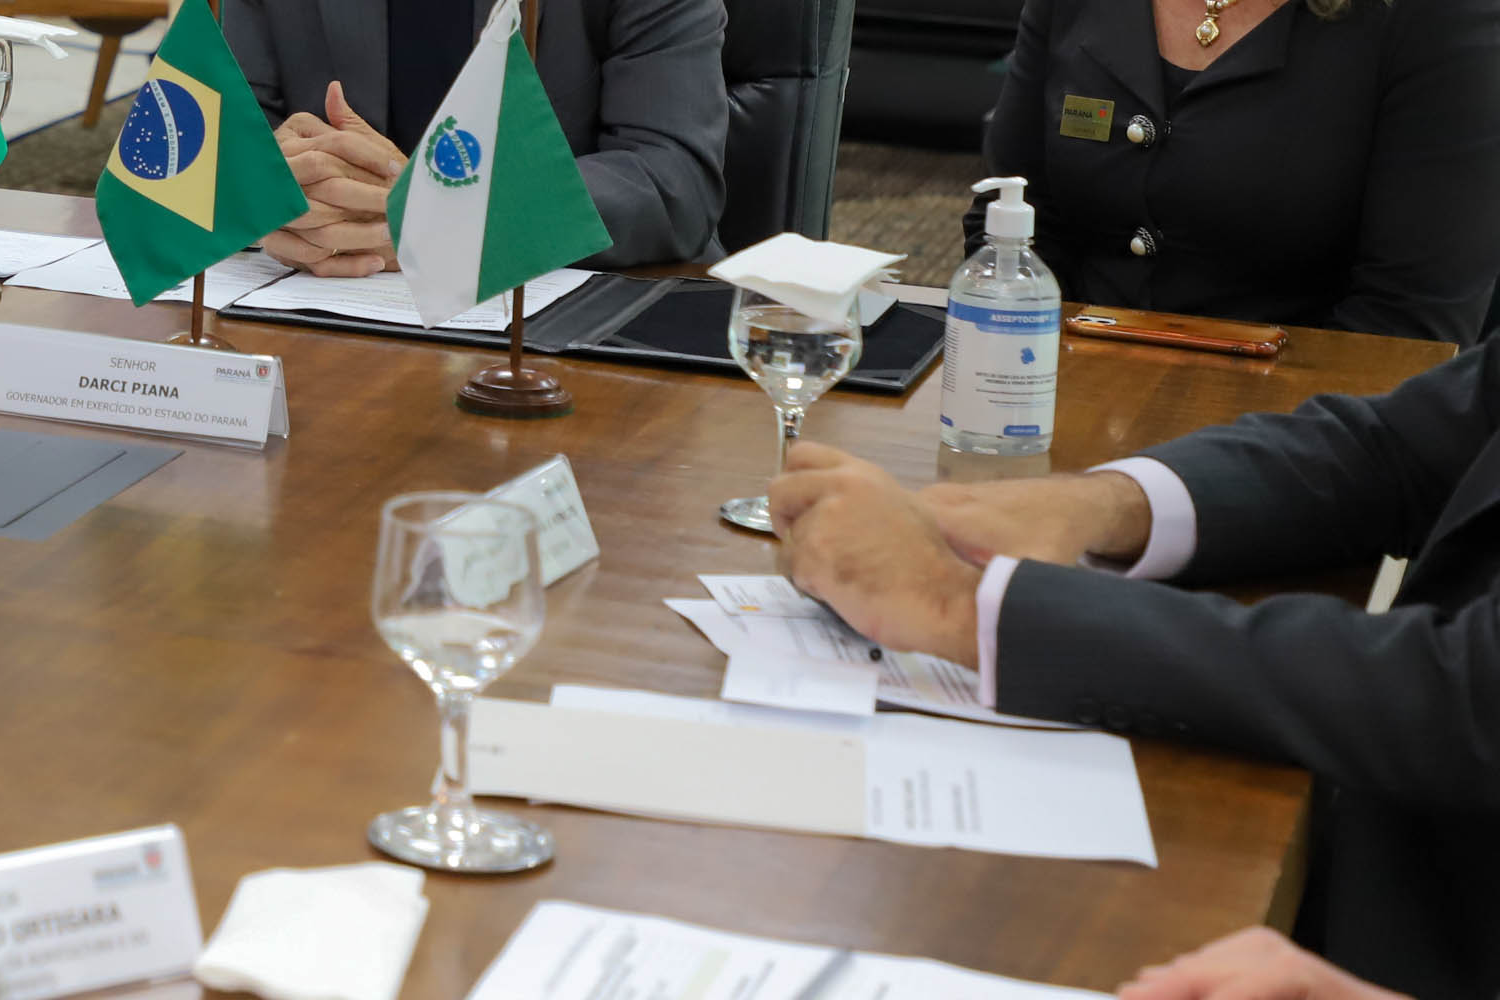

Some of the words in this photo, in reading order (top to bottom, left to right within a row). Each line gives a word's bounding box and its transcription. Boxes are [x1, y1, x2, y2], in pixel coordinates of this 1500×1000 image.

[109, 357, 157, 373] SENHOR
[78, 376, 127, 393] DARCI
[131, 381, 180, 399] PIANA
[5, 391, 69, 408] GOVERNADOR
[70, 399, 84, 409] EM
[138, 405, 152, 417] DO
[154, 407, 192, 422] ESTADO
[194, 411, 209, 423] DO
[211, 413, 248, 429] PARANÁ
